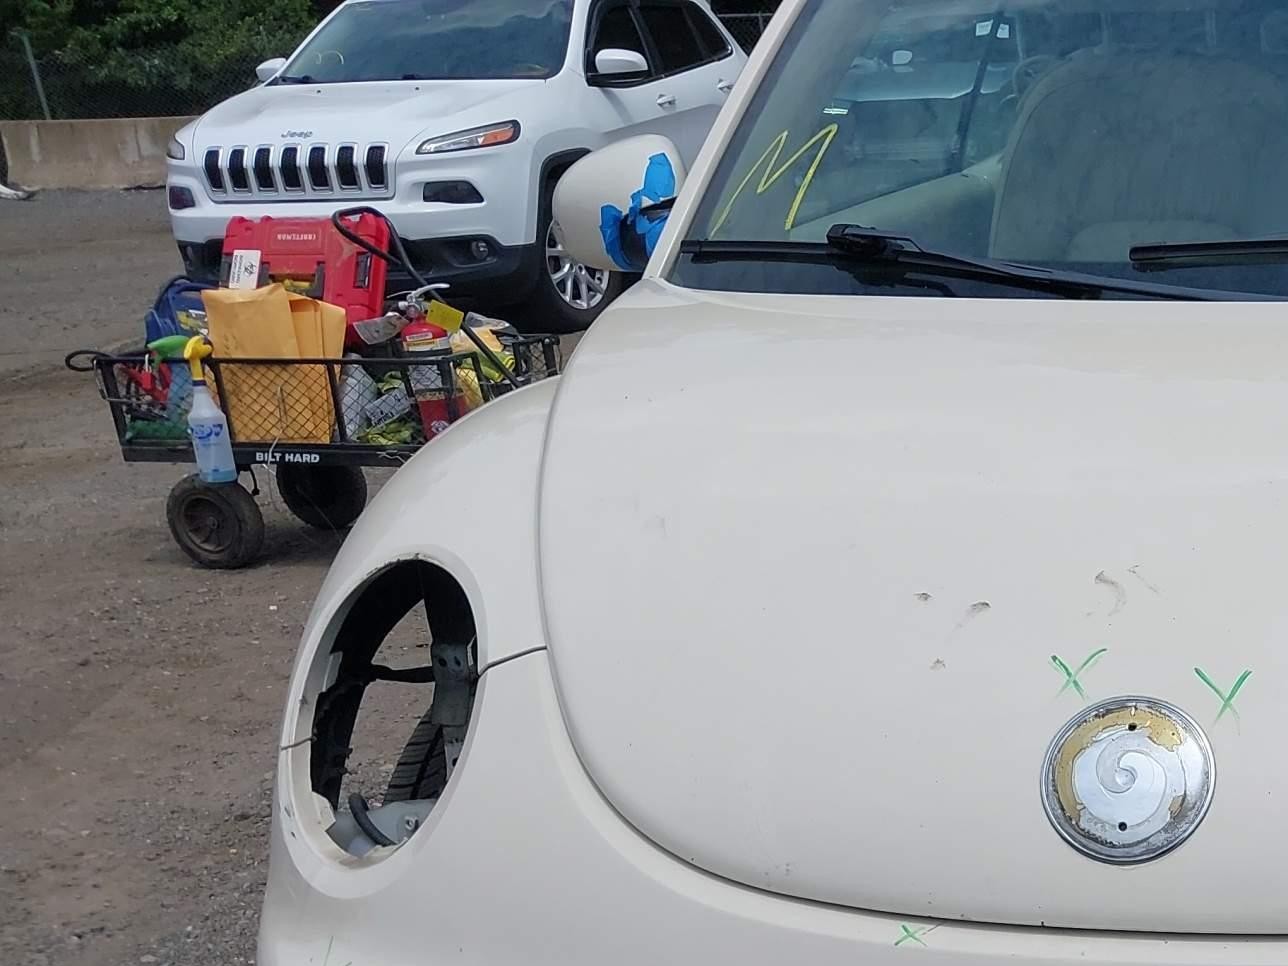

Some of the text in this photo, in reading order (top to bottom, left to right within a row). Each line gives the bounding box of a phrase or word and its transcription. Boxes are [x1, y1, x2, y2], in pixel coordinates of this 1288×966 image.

[280, 129, 313, 139] Jeep
[255, 452, 320, 463] BILT HARD
